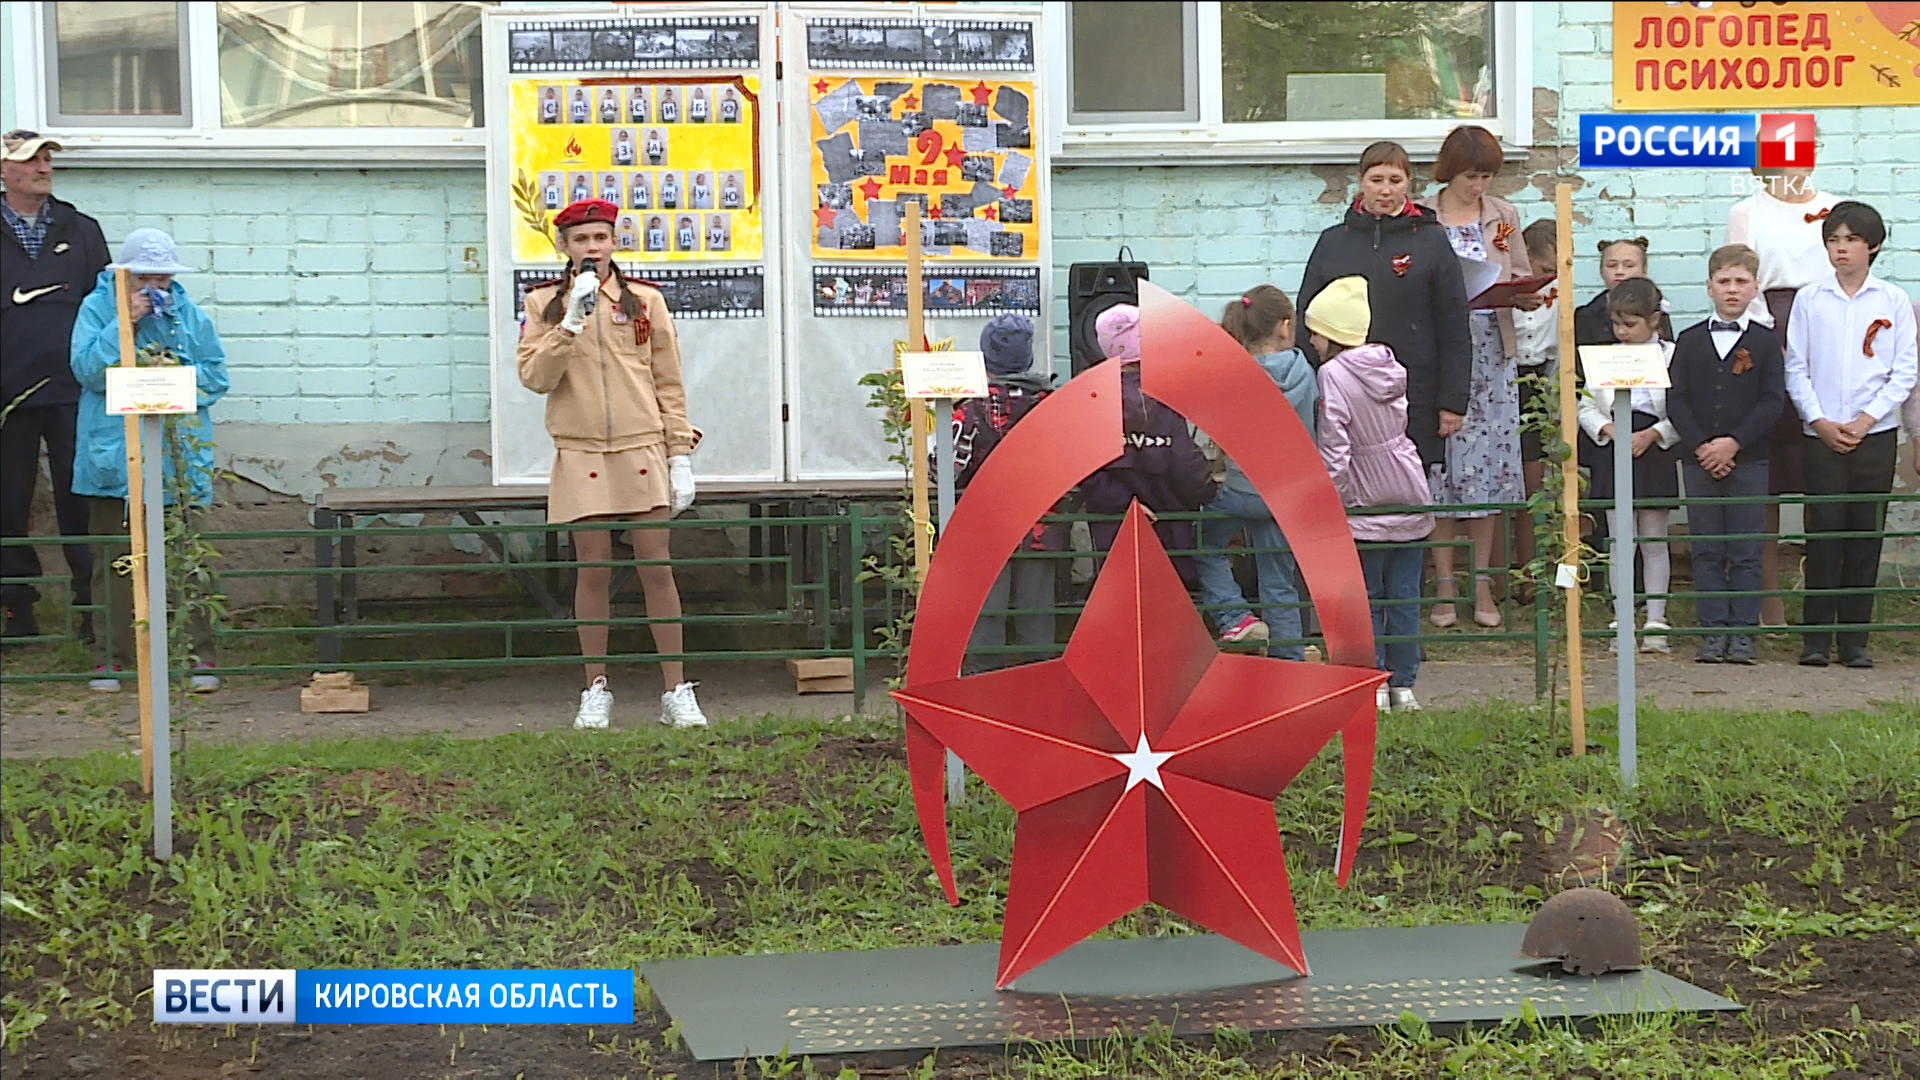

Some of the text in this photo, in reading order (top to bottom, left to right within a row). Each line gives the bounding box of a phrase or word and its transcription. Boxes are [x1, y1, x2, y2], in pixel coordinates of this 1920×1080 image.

[1634, 13, 1831, 51] ЛОГОПЕД
[1635, 55, 1856, 92] ПСИХОЛОГ
[917, 128, 943, 165] 9
[889, 165, 948, 185] Мая
